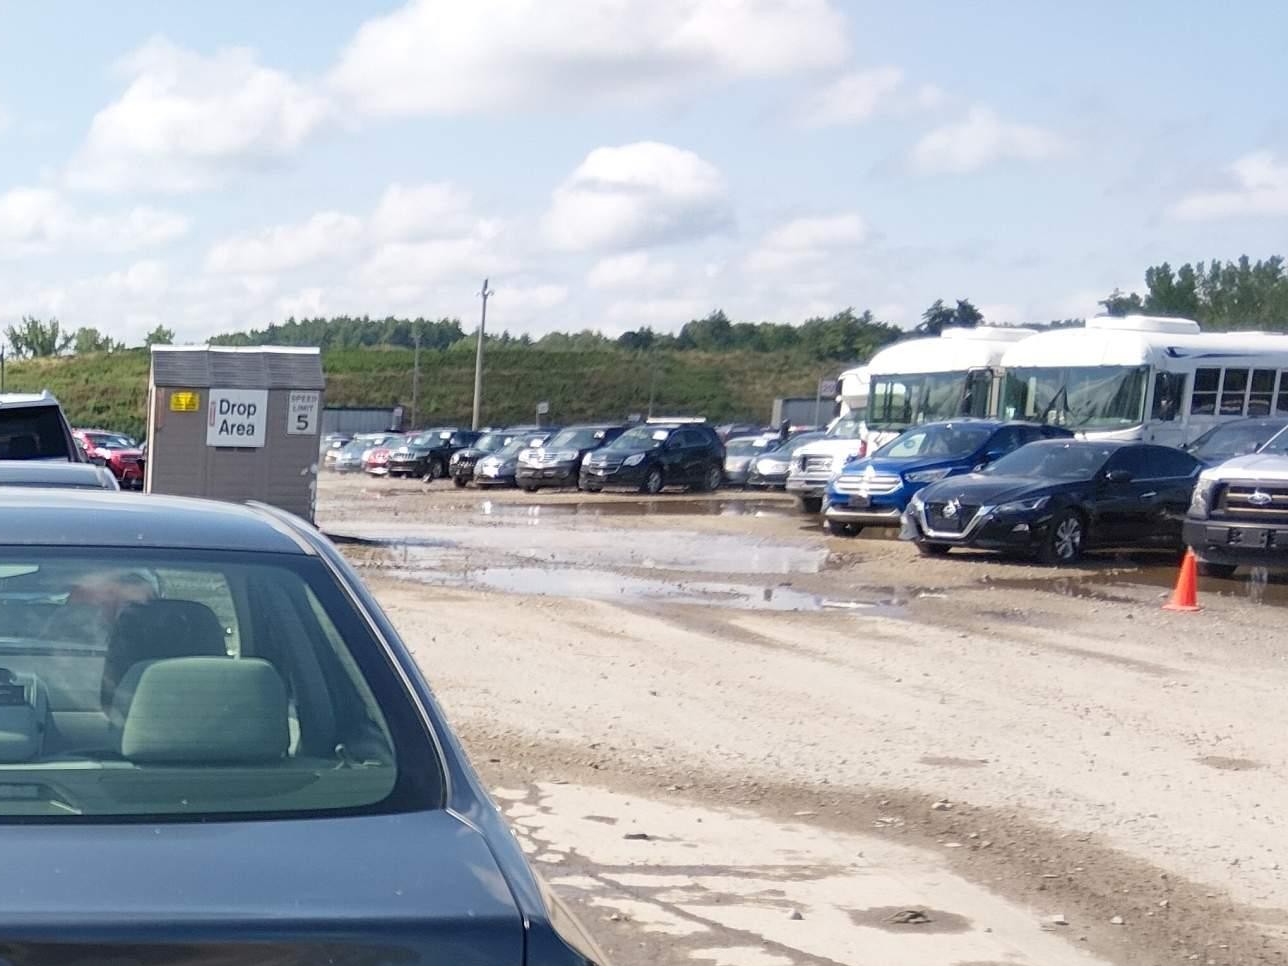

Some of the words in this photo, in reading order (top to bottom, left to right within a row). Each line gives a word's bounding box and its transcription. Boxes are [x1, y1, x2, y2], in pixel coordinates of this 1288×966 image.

[219, 398, 257, 419] Drop
[218, 419, 255, 436] Area
[296, 414, 309, 431] 5
